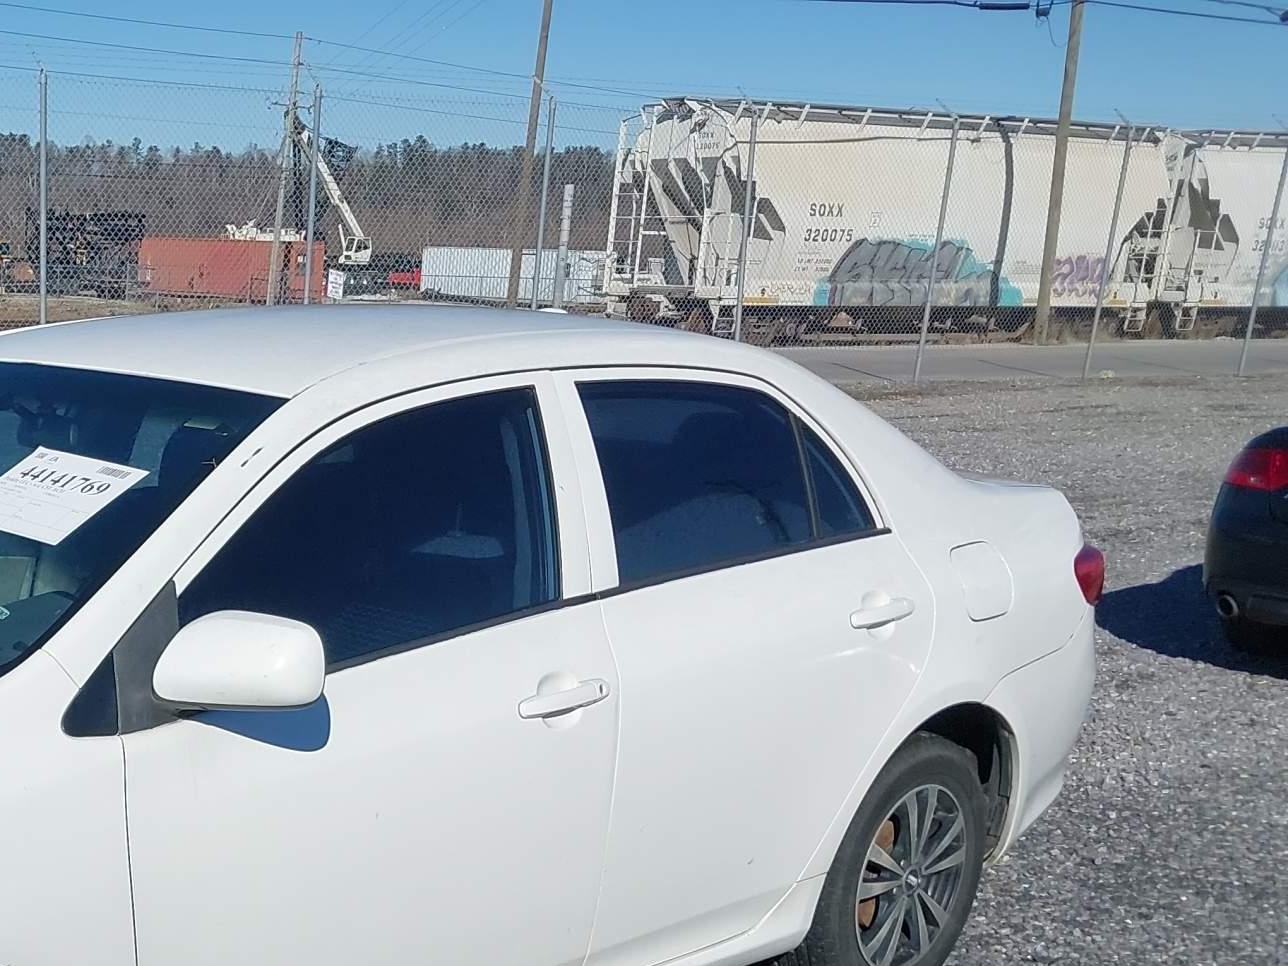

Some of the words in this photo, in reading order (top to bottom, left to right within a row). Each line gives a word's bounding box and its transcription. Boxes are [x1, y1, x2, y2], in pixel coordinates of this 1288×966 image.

[809, 202, 845, 217] SOXX
[804, 228, 854, 243] 320075
[20, 465, 112, 496] 44141769
